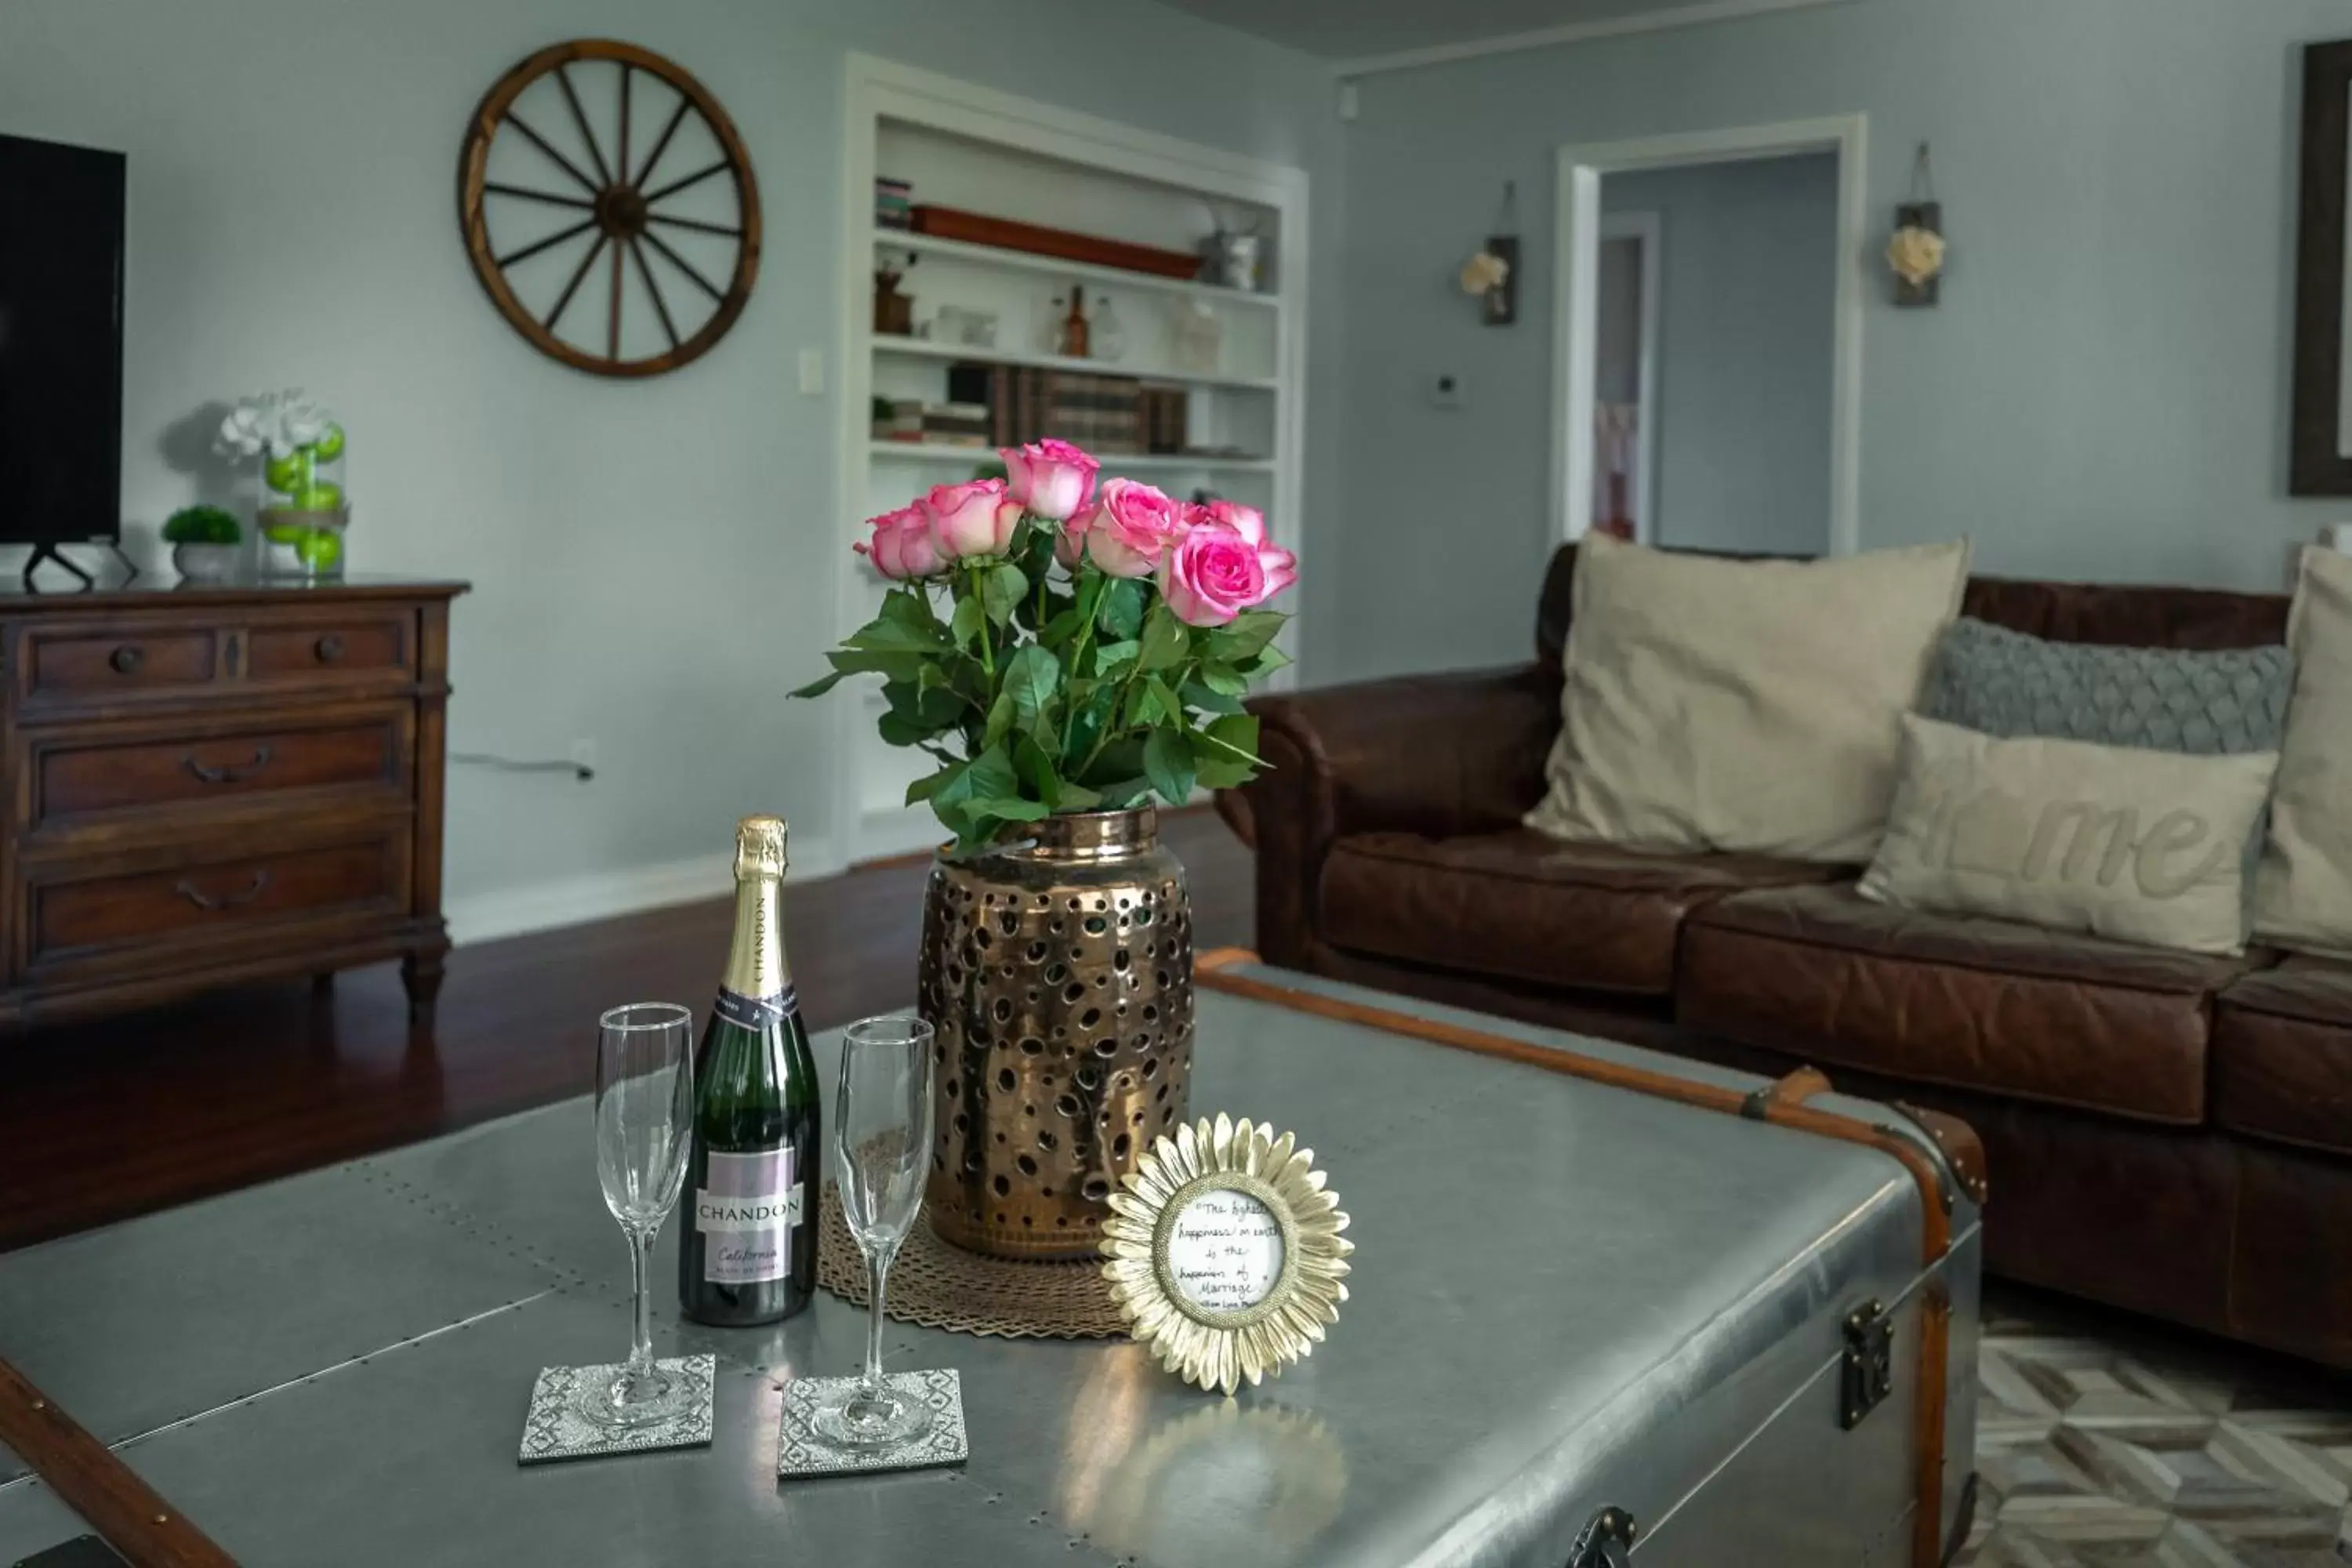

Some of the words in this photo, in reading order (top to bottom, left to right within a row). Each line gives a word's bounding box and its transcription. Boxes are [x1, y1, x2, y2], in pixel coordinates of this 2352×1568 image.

[753, 898, 765, 982] CHANDON
[700, 1199, 799, 1221] CHANDON
[718, 1247, 777, 1262] California
[1199, 1281, 1255, 1299] Marriage
